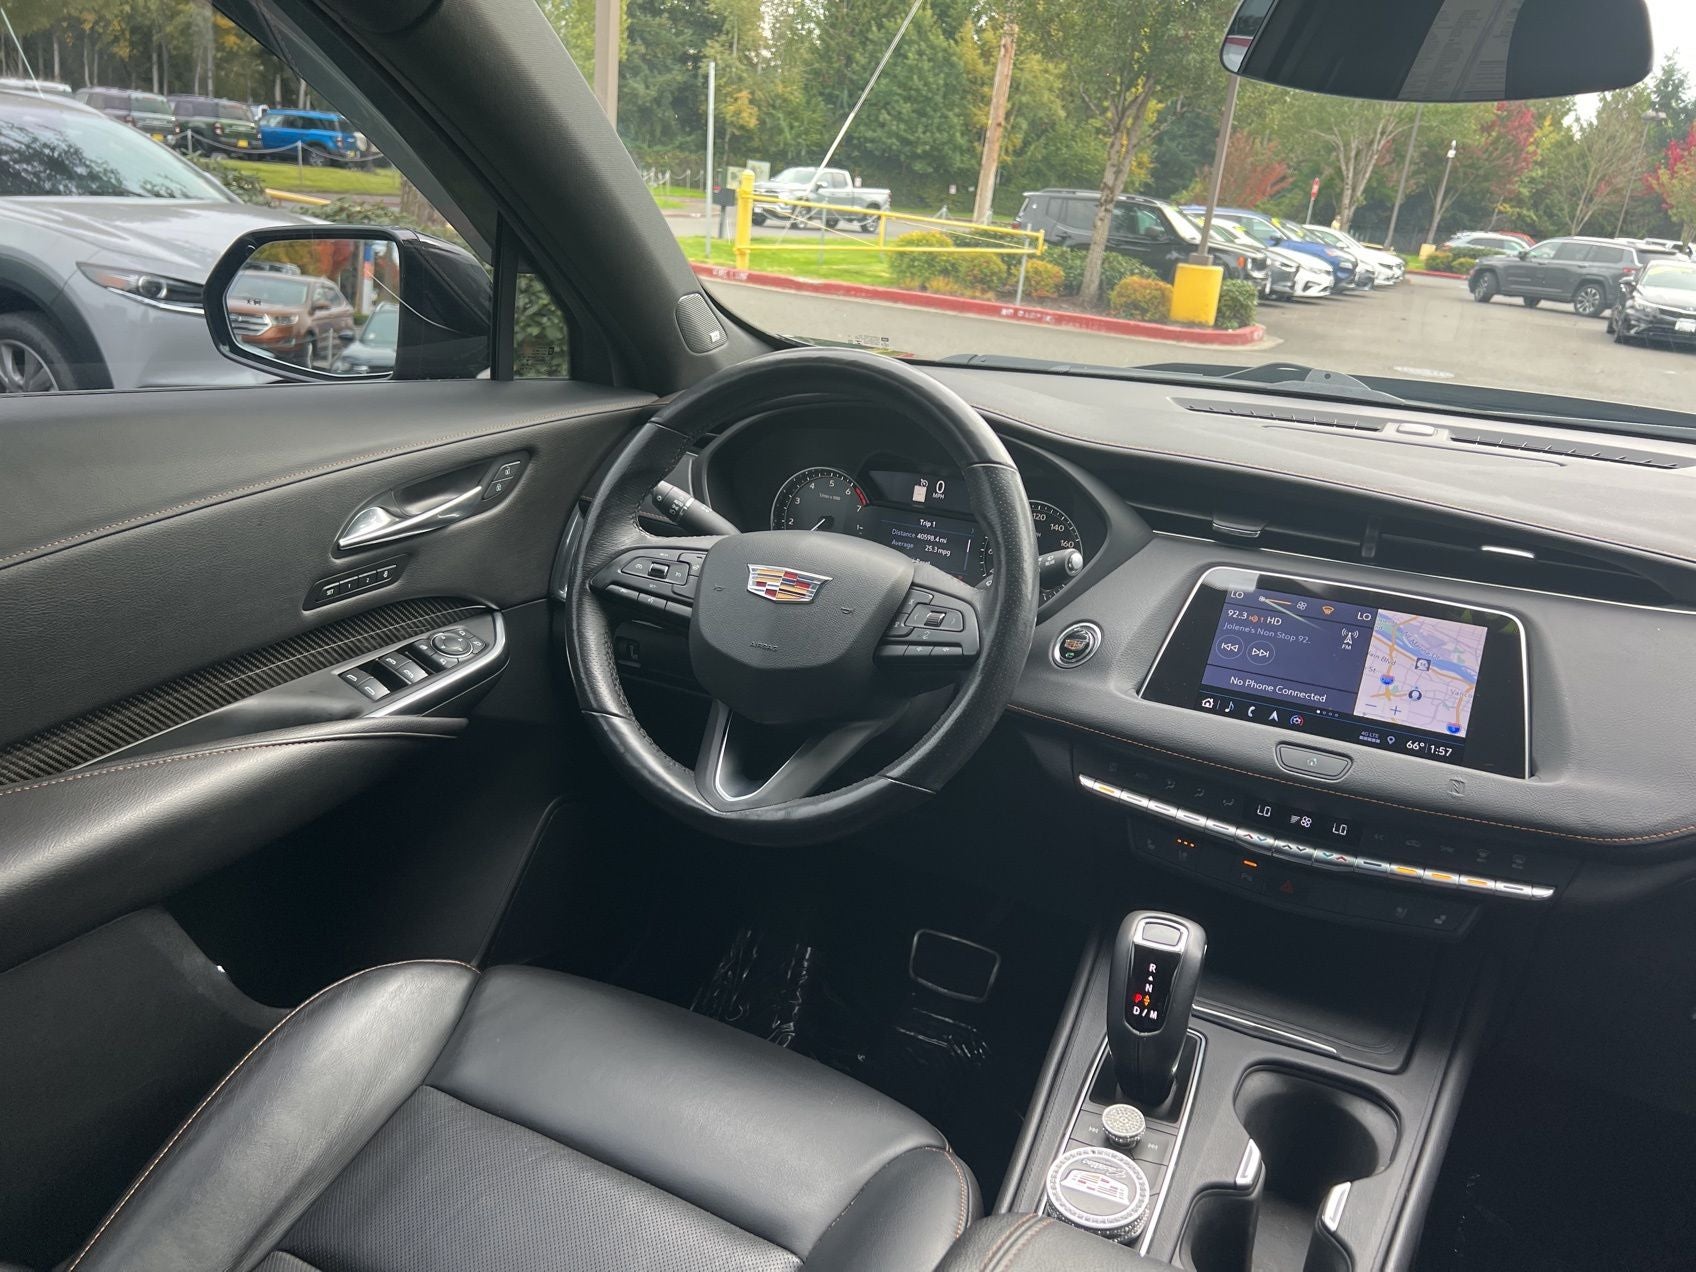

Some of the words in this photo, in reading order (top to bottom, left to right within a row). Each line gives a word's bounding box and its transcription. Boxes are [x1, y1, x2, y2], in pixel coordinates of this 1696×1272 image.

[809, 482, 816, 490] 4
[829, 479, 836, 488] 5
[936, 480, 946, 494] 0
[845, 487, 852, 496] 6
[932, 492, 945, 500] MPH
[794, 496, 801, 505] 3
[856, 504, 863, 513] 7
[788, 518, 795, 526] 2
[1032, 513, 1047, 521] 120
[919, 518, 932, 529] Trip
[1049, 523, 1065, 532] 140
[891, 528, 916, 539] Distance
[916, 532, 940, 543] 40598.4
[939, 537, 949, 545] mi
[891, 539, 914, 550] Average
[924, 544, 938, 553] 25.3
[937, 547, 951, 558] mpg
[1060, 540, 1075, 548] 160
[326, 588, 335, 596] SET
[1230, 589, 1245, 599] LO
[1227, 609, 1248, 620] 92.3
[1267, 616, 1283, 626] HD
[1357, 611, 1372, 621] LO
[1223, 622, 1256, 634] Jolene's
[1256, 627, 1276, 638] Non
[1276, 631, 1297, 643] Stop
[1229, 676, 1244, 686] No
[1244, 678, 1275, 692] Phone
[1275, 684, 1328, 703] Connected
[1406, 740, 1425, 751] 66°
[1429, 744, 1454, 757] 1:57
[1257, 804, 1271, 817] LO
[1332, 823, 1347, 835] LO
[1148, 962, 1157, 973] R
[1145, 983, 1154, 993] N
